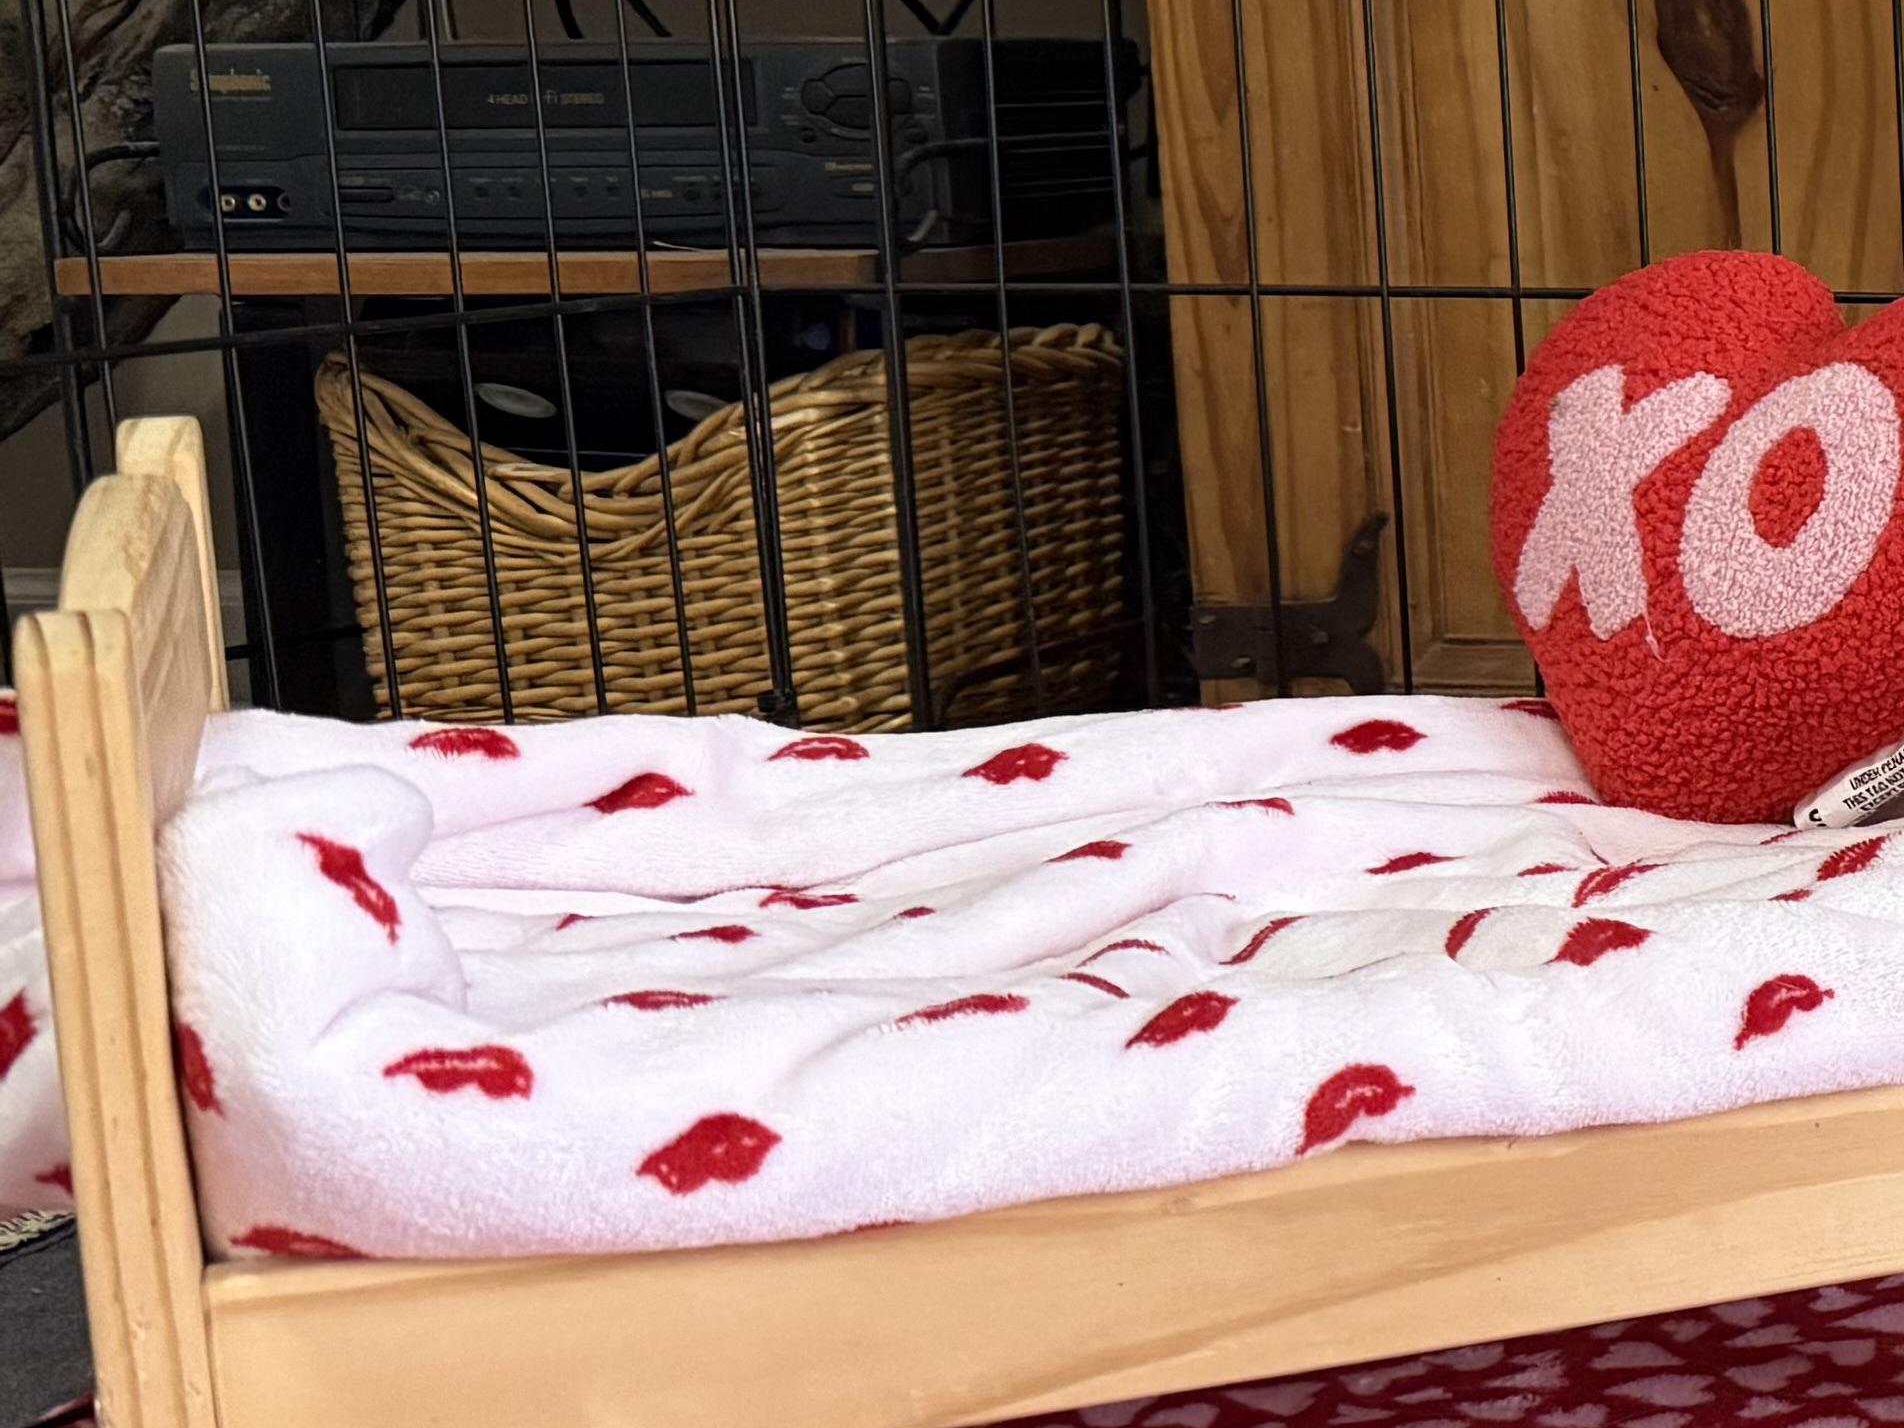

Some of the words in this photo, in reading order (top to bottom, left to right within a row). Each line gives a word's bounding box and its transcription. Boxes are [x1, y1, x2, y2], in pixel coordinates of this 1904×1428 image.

[1513, 362, 1901, 641] XO
[1850, 765, 1882, 790] UNDER
[1842, 792, 1868, 810] THIS
[1866, 780, 1888, 796] TAG
